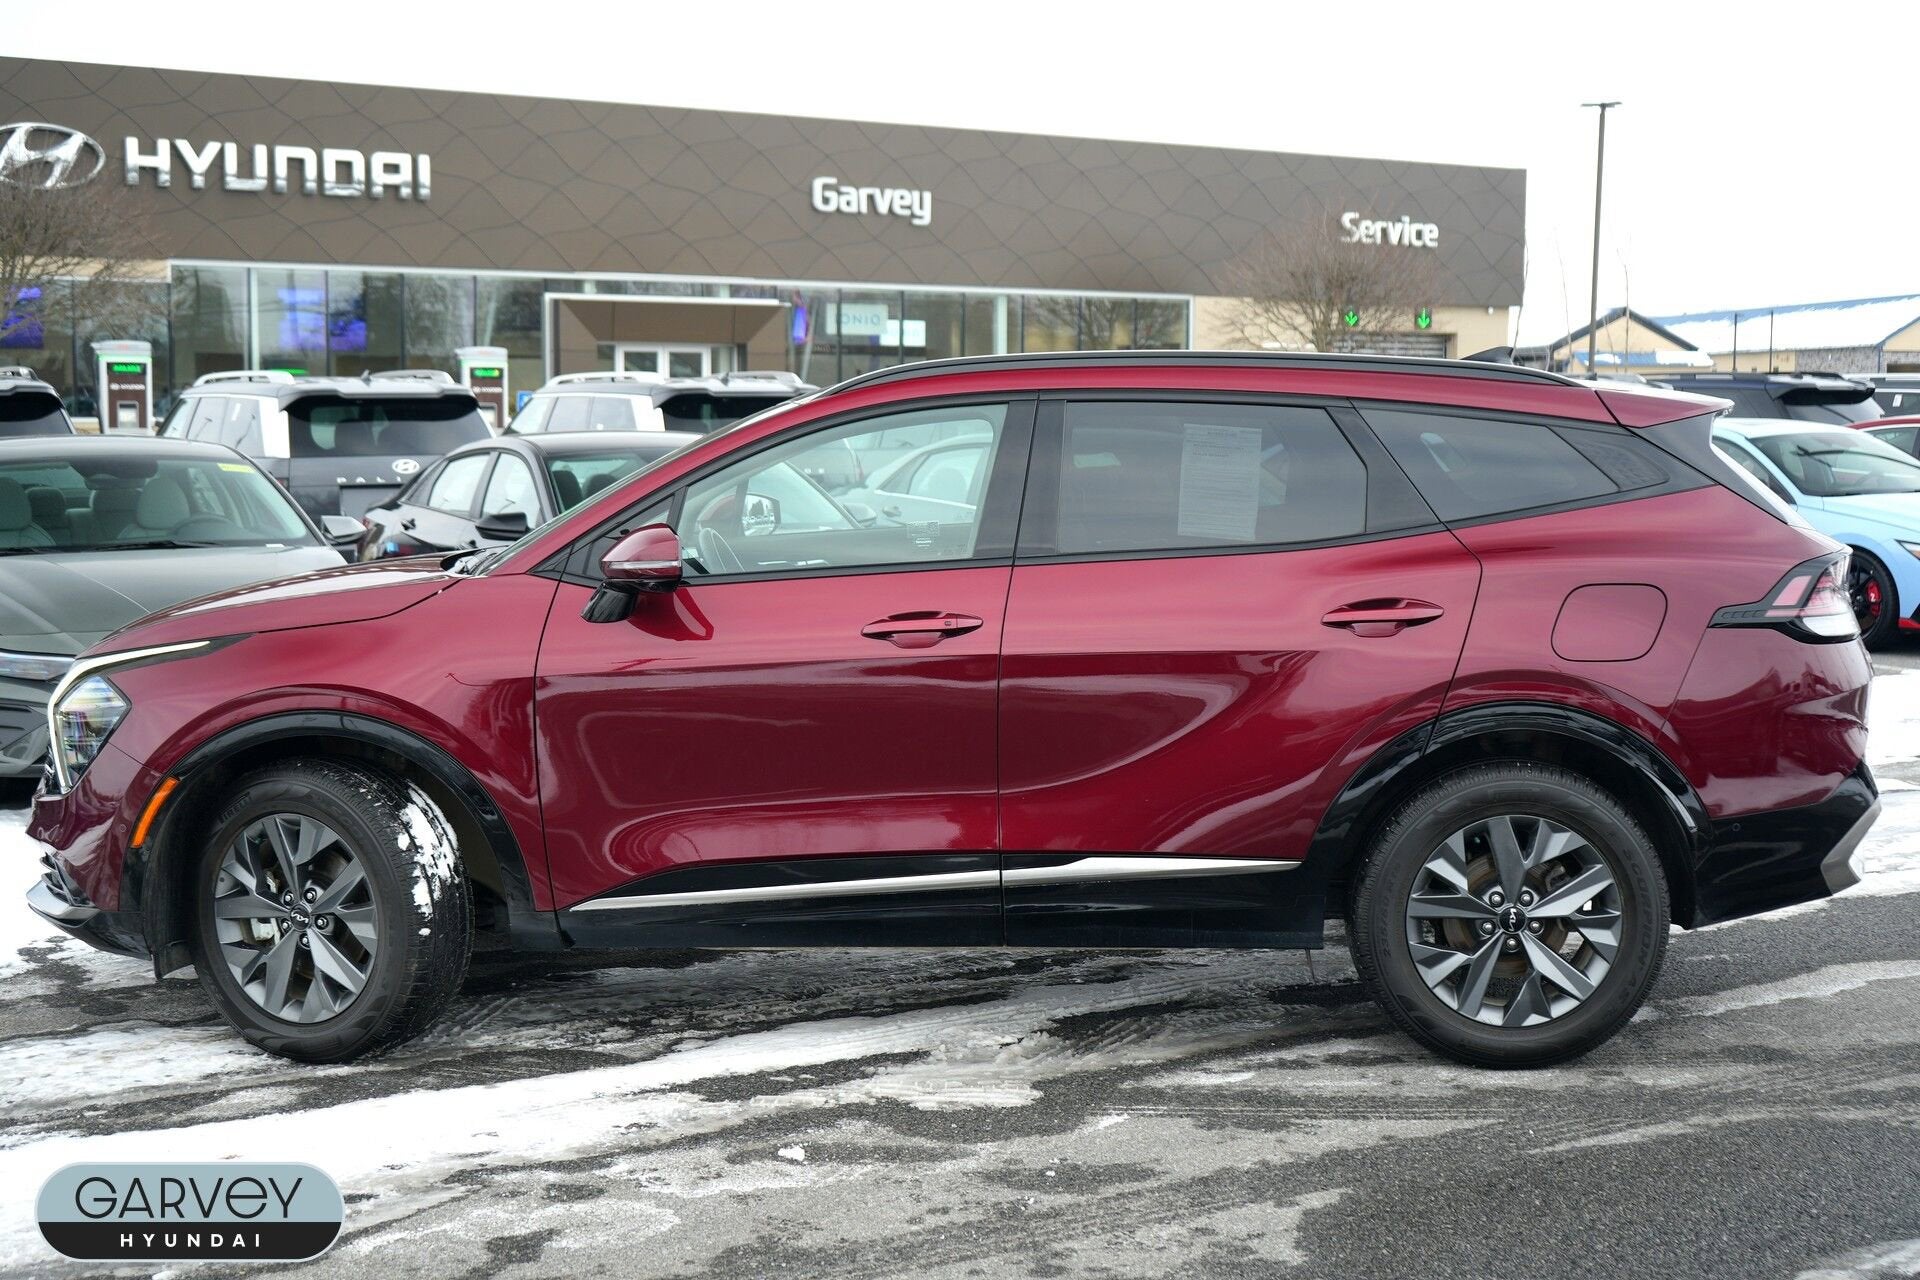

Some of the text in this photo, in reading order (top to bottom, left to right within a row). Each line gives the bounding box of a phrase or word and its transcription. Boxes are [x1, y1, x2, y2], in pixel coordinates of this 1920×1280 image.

[124, 136, 431, 200] HYUNDAI
[812, 176, 932, 226] Garvey
[1340, 211, 1439, 248] Service
[839, 313, 882, 326] ONIQ
